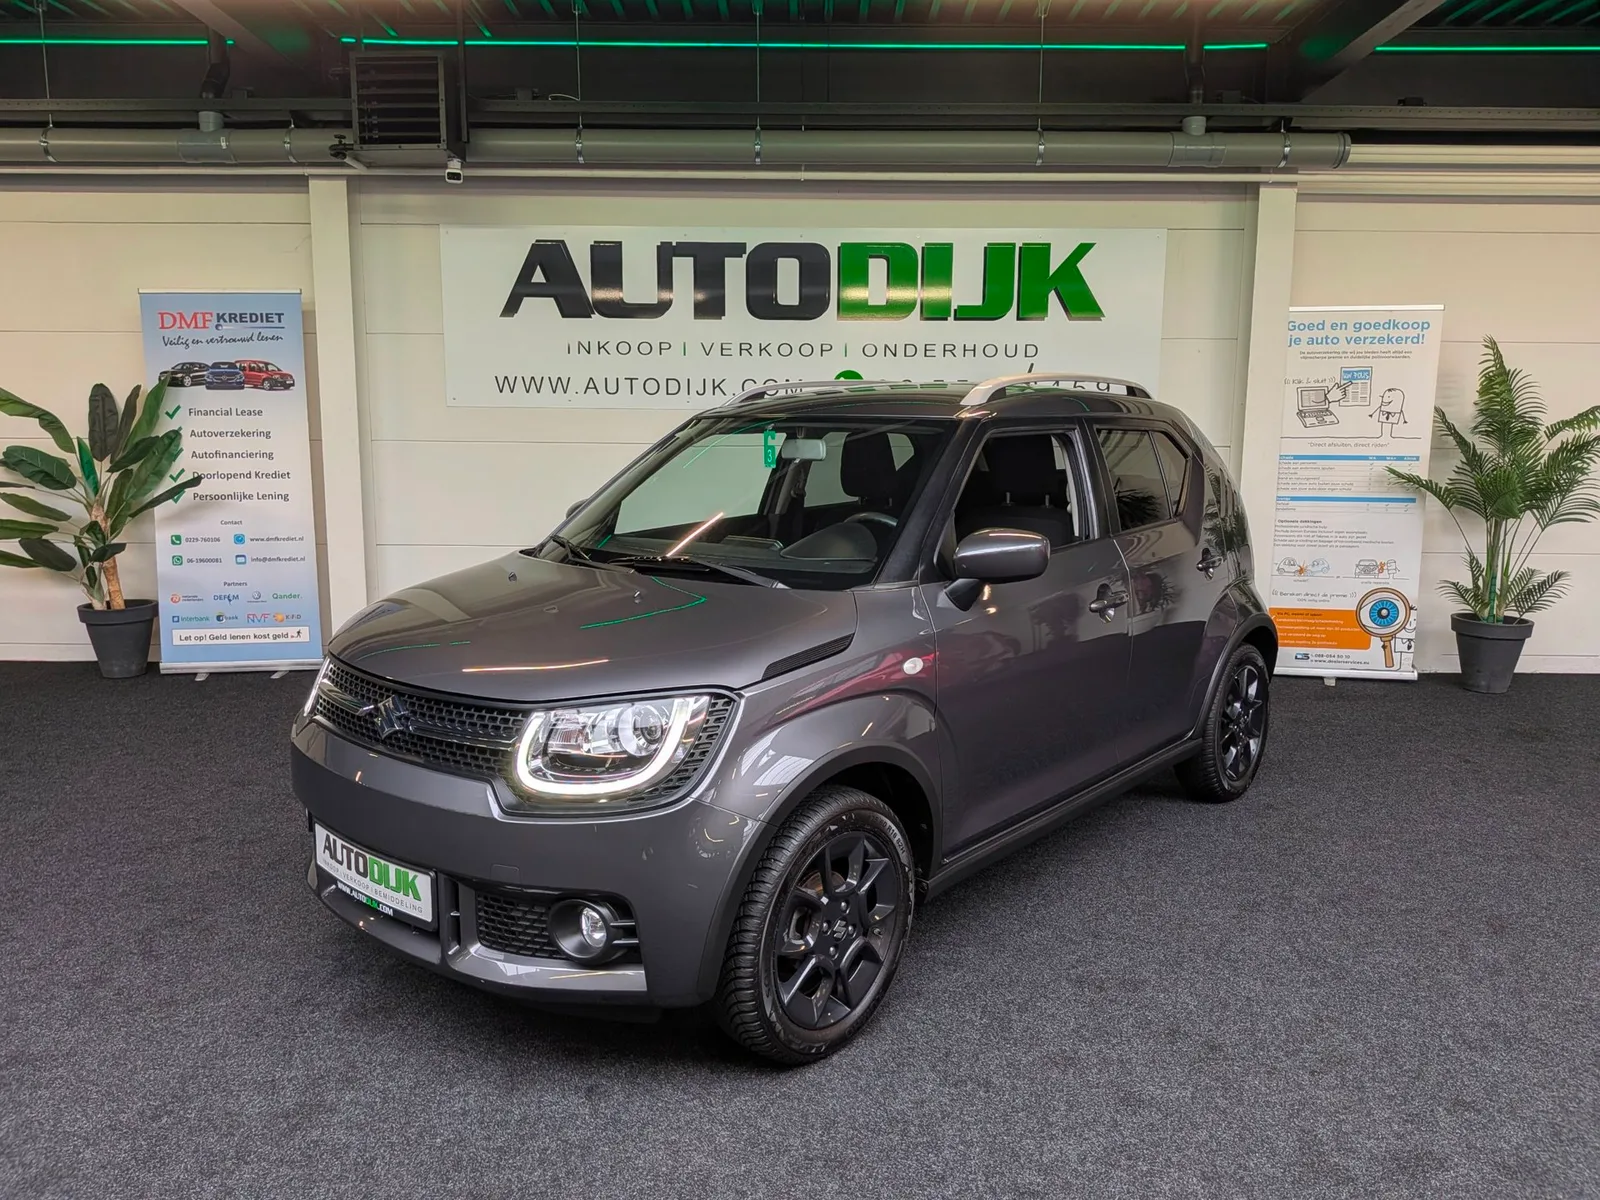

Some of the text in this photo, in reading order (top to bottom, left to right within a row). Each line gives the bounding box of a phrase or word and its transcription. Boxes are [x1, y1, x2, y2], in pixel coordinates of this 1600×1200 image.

[499, 239, 1106, 322] AUTODIJK
[158, 312, 285, 330] DMF KREDIET
[1288, 319, 1430, 333] Goed en goedkoop
[162, 331, 283, 350] Veilig en vertrouwd lenen
[1288, 333, 1425, 347] je auto verzekerd!
[566, 340, 1039, 359] INKOOP VERKOOP ONDERHOUD
[188, 407, 263, 417] Financial Lease
[190, 428, 272, 440] Autoverzekering
[191, 449, 274, 461] Autofinanciering
[767, 449, 773, 463] 3
[254, 470, 291, 480] Krediet
[193, 491, 290, 502] Persoonlijke Lening
[185, 535, 304, 544] 0229-760106 www.dmfkrediet.nl
[179, 629, 289, 644] Let op! Geld lenen kost geld
[323, 833, 422, 901] AUTODIJK
